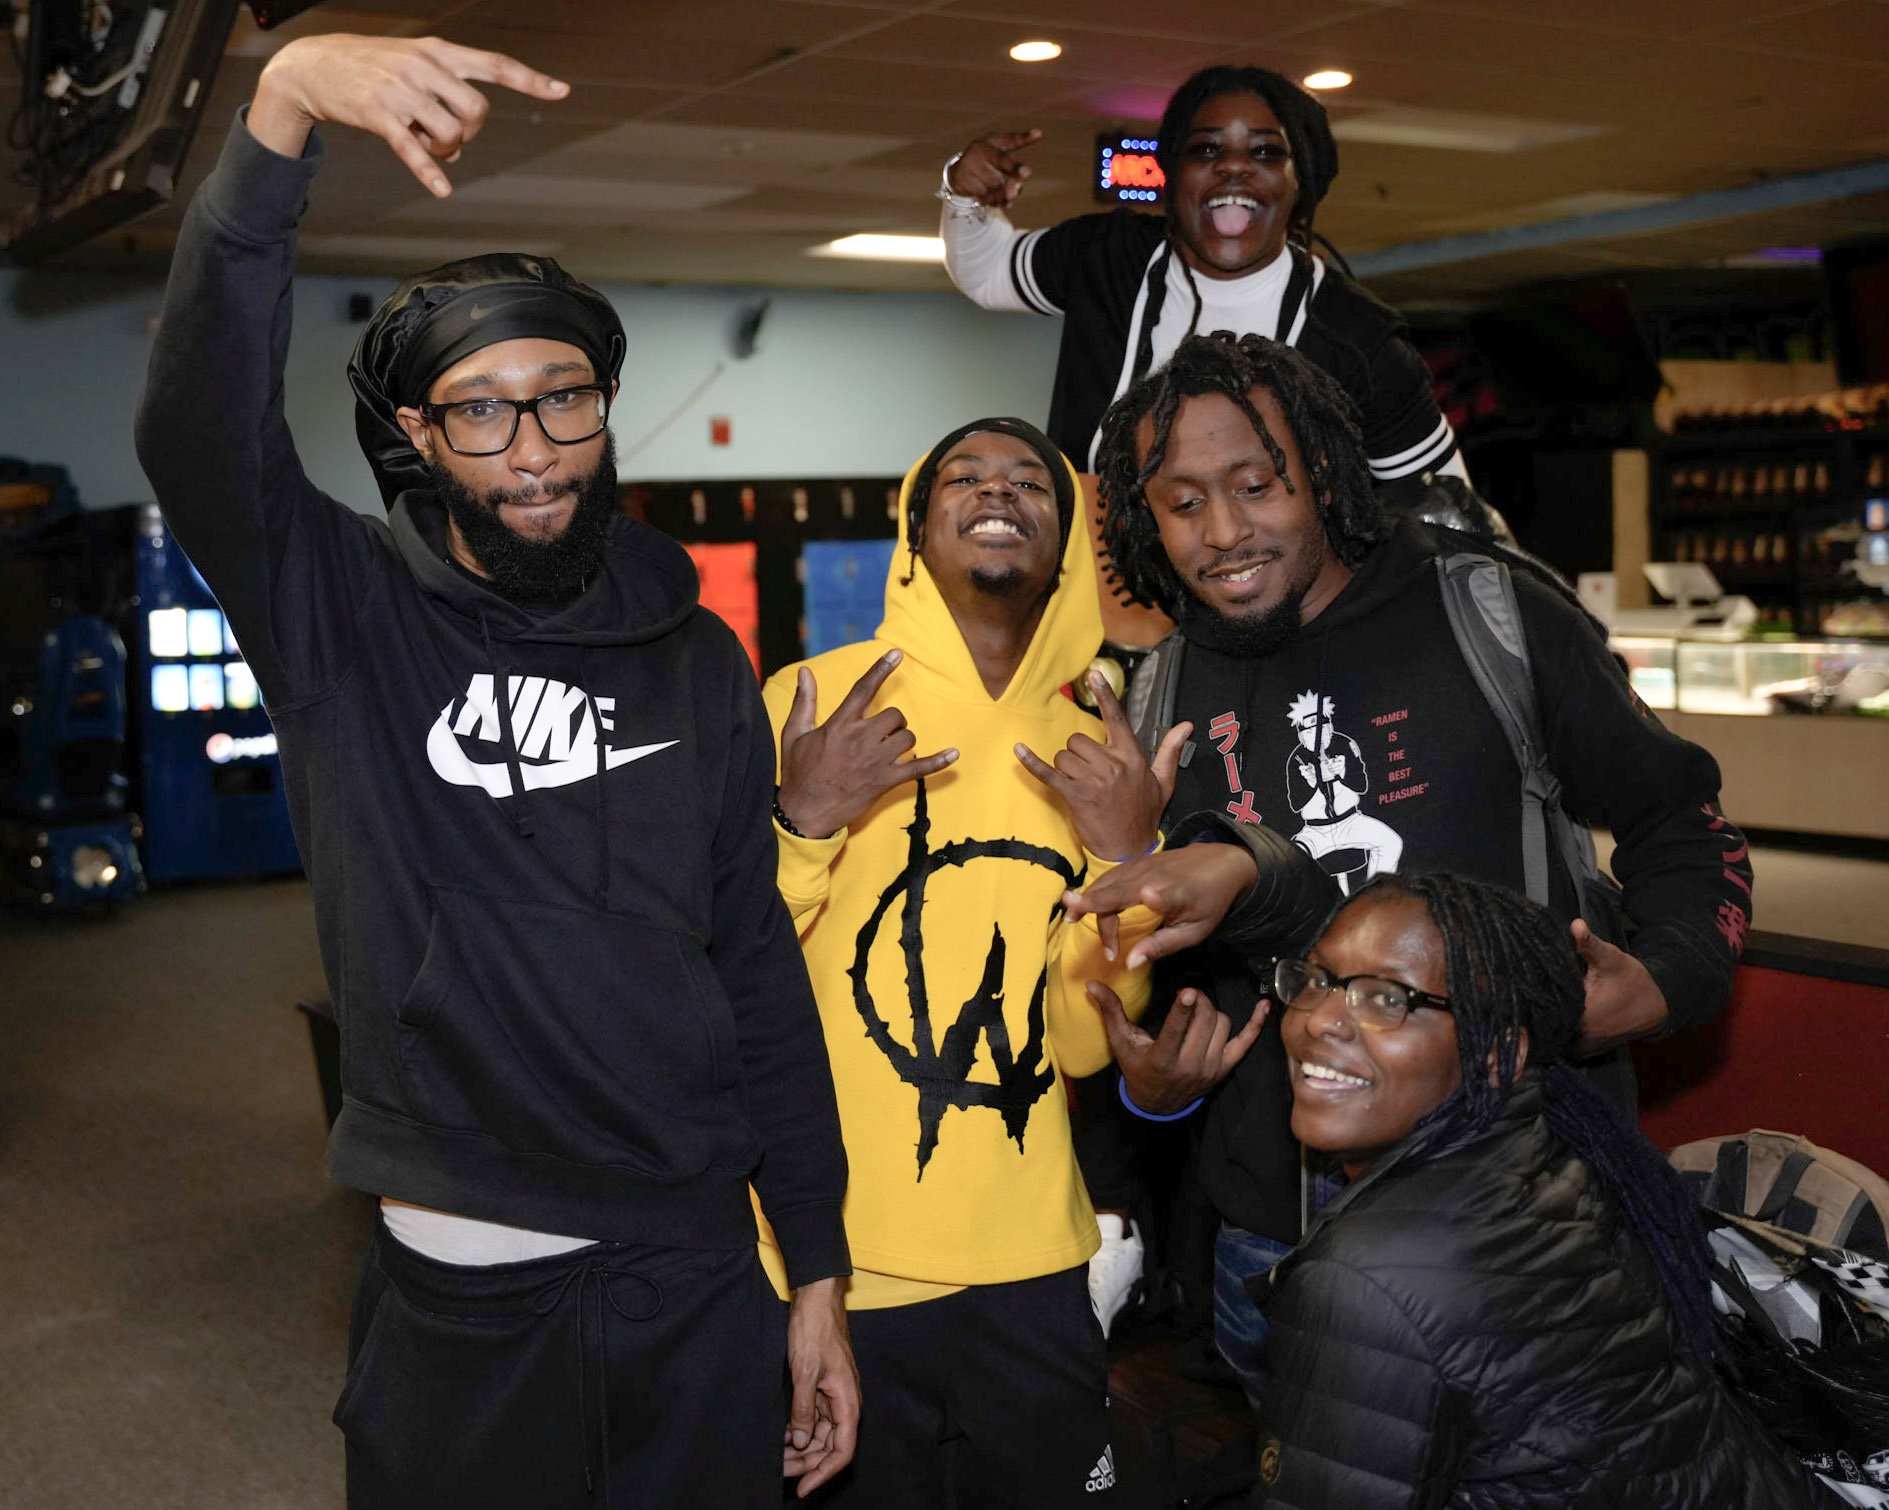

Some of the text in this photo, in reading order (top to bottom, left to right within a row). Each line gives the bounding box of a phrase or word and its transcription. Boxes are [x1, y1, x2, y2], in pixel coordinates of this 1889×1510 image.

[453, 673, 616, 761] NIKE
[1371, 709, 1409, 727] "RAMEN
[1388, 731, 1398, 743] IS
[1388, 749, 1406, 763] THE
[1388, 767, 1412, 783] BEST
[1379, 782, 1430, 805] PLEASURE"
